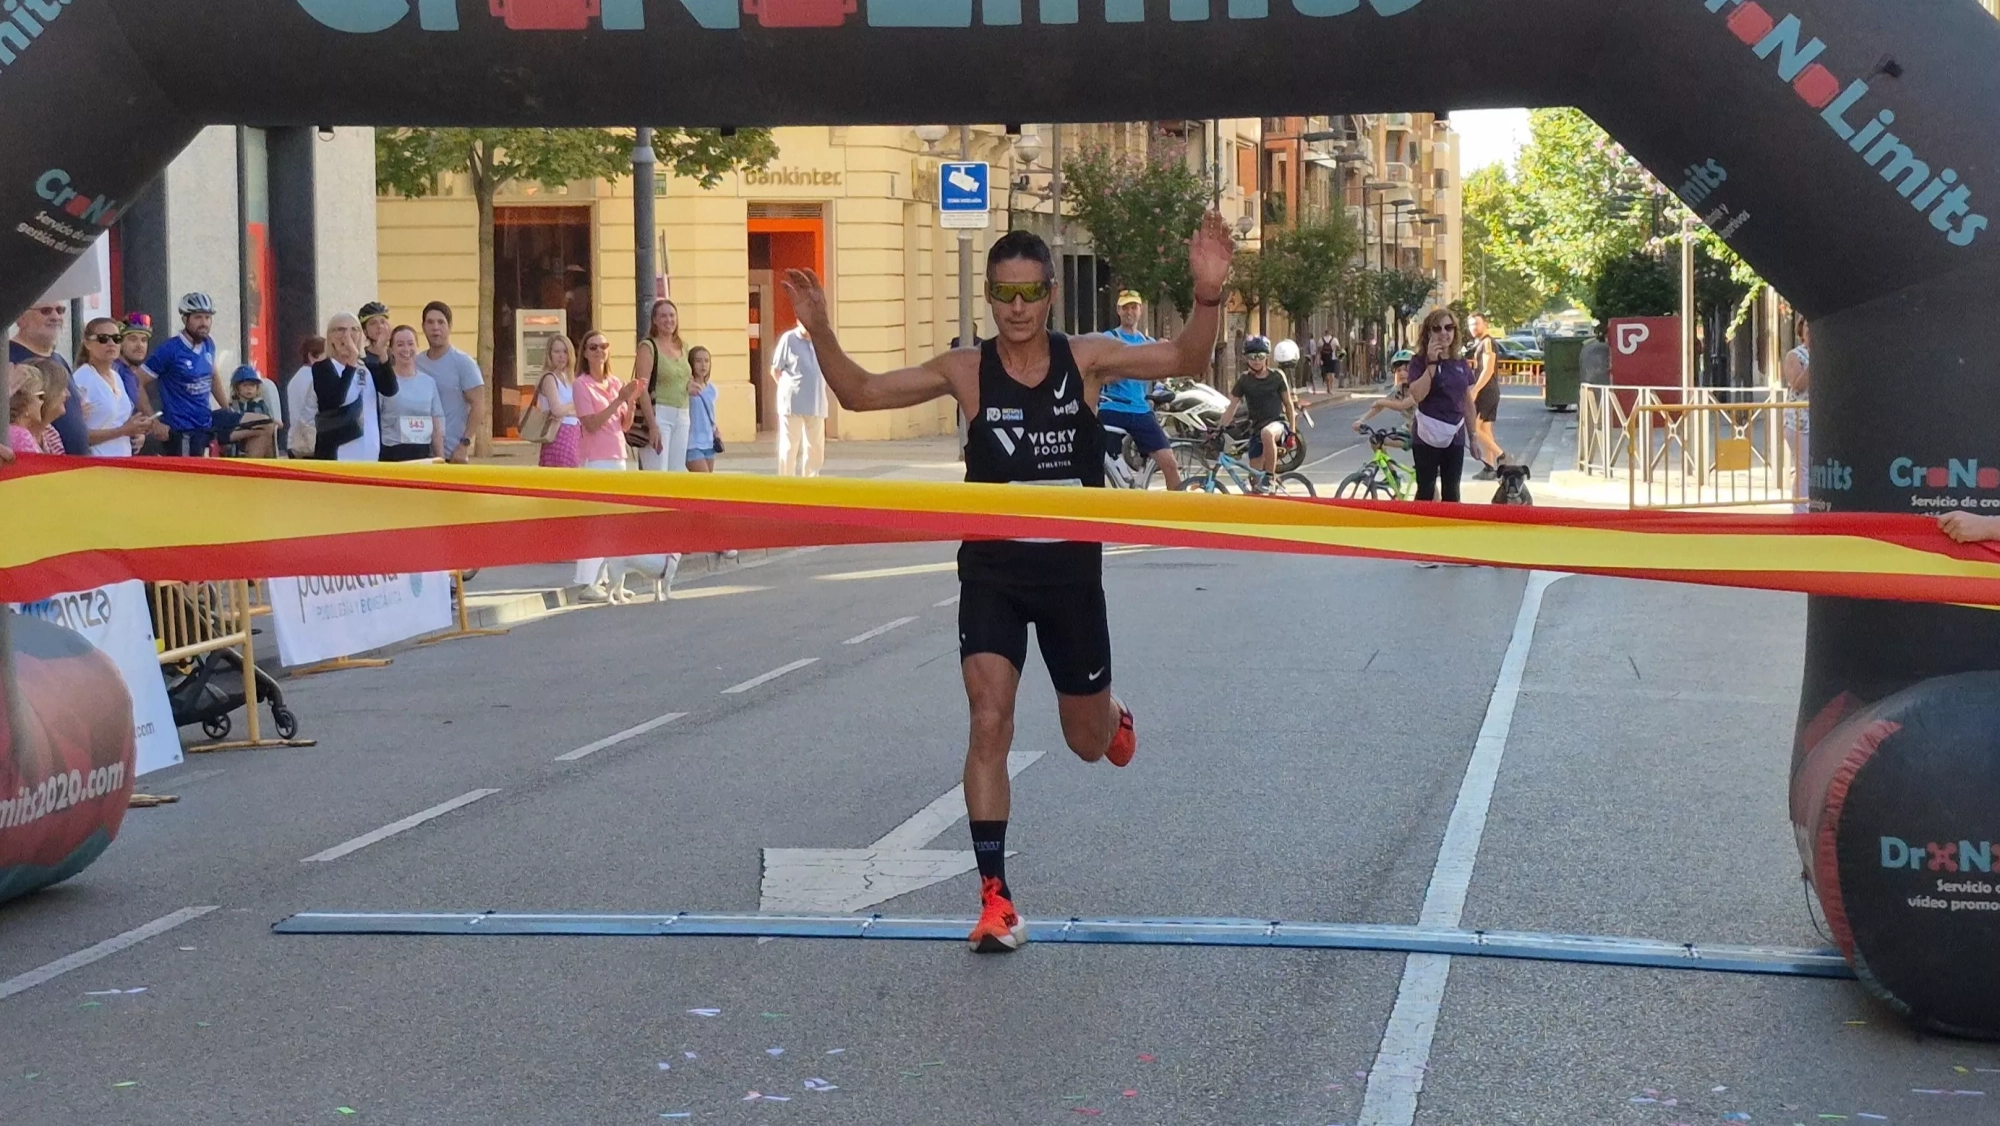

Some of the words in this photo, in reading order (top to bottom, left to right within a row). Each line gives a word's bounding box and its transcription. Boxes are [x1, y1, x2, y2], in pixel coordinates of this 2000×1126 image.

[1028, 428, 1077, 446] VICKY
[1034, 442, 1074, 456] FOODS
[1911, 495, 1957, 508] Servicio
[1960, 496, 1977, 508] de
[1937, 879, 1993, 894] Servicio
[1907, 894, 1949, 909] vídeo
[1950, 899, 2000, 912] promo
